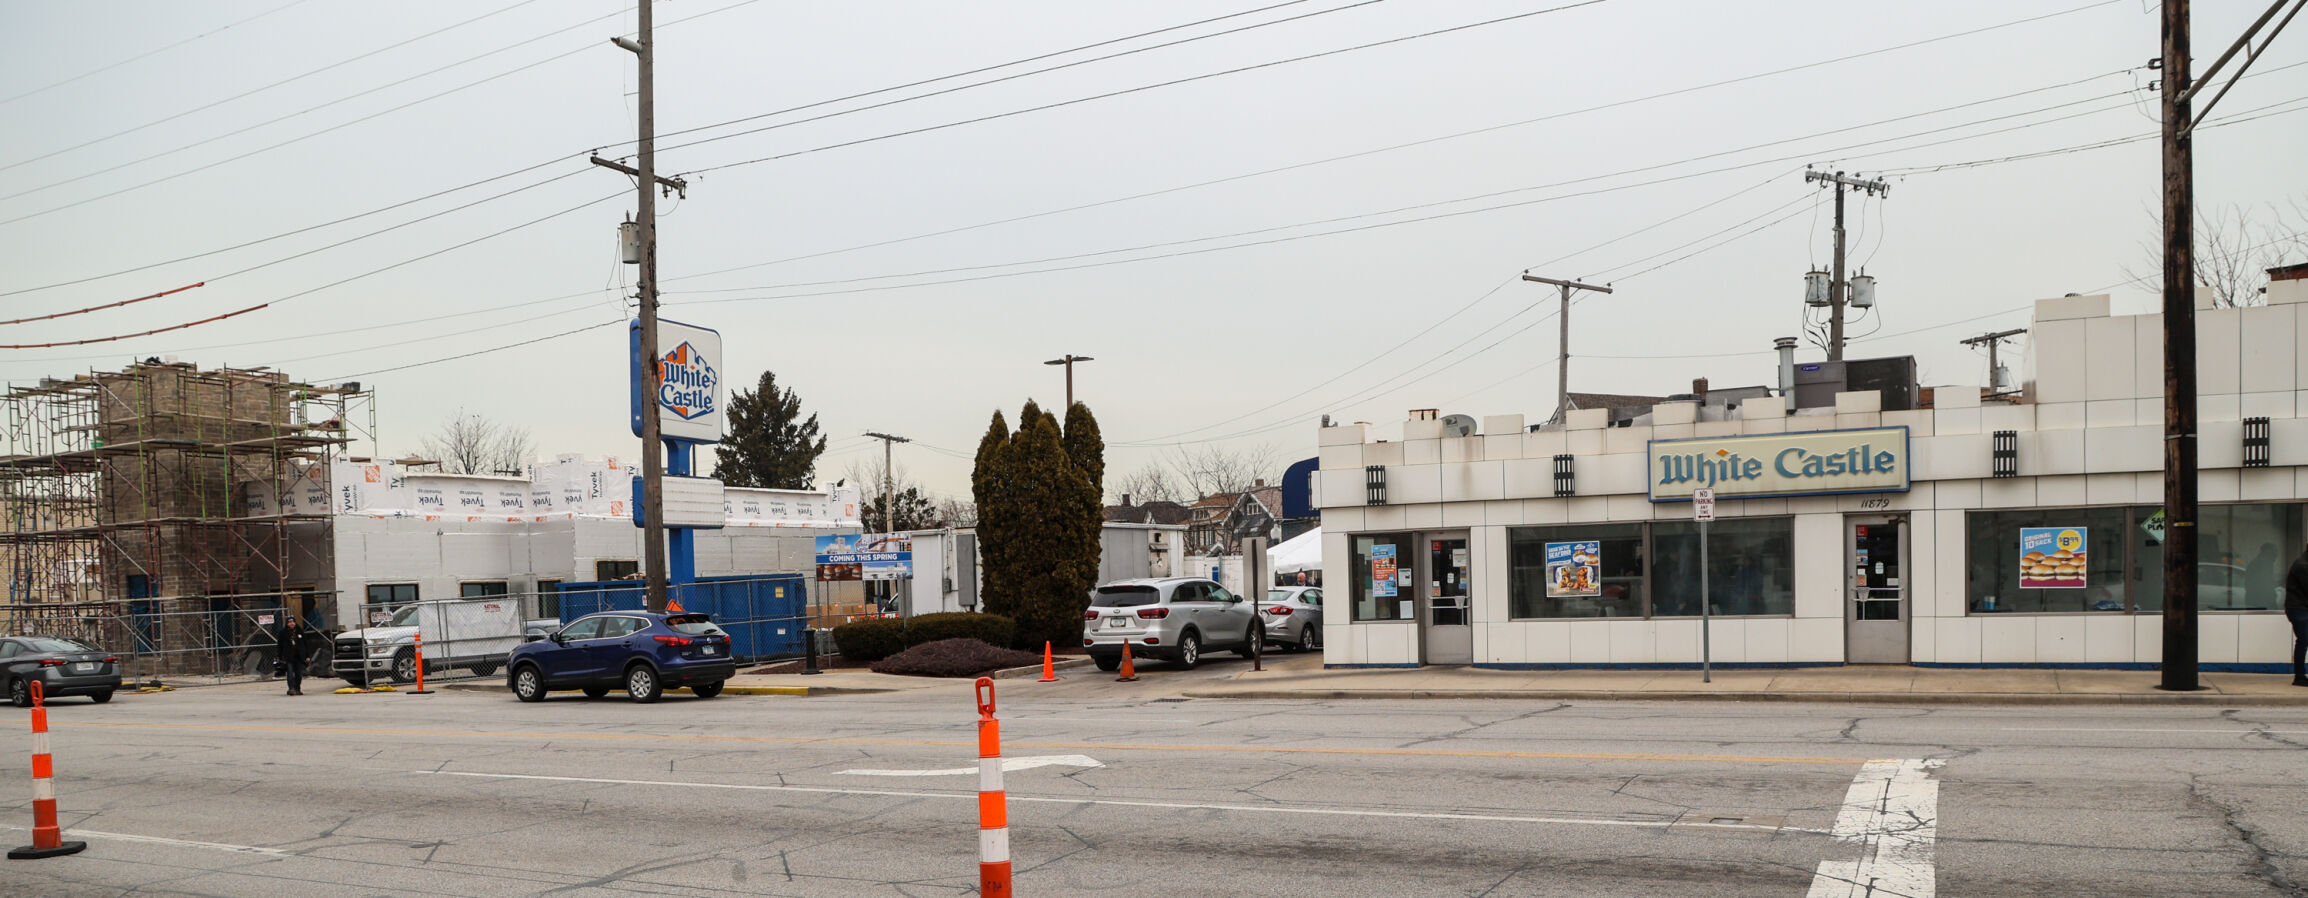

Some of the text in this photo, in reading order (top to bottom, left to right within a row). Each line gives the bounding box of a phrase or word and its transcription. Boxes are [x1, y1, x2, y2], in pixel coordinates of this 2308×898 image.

[664, 361, 712, 389] White
[660, 384, 712, 409] Castle
[1659, 443, 1895, 488] White Castle
[308, 494, 327, 505] Tyvek
[419, 496, 444, 506] Tyvek
[461, 496, 485, 507] Tyvek
[501, 497, 524, 508] Tyvek
[532, 496, 553, 506] Tyvek
[1861, 498, 1889, 508] 11879
[744, 506, 760, 515] Tyvek
[772, 506, 787, 515] Tyvek
[798, 507, 812, 516] Tyvek
[2024, 532, 2052, 542] ORIGINAL
[2025, 537, 2052, 549] 10 SACK
